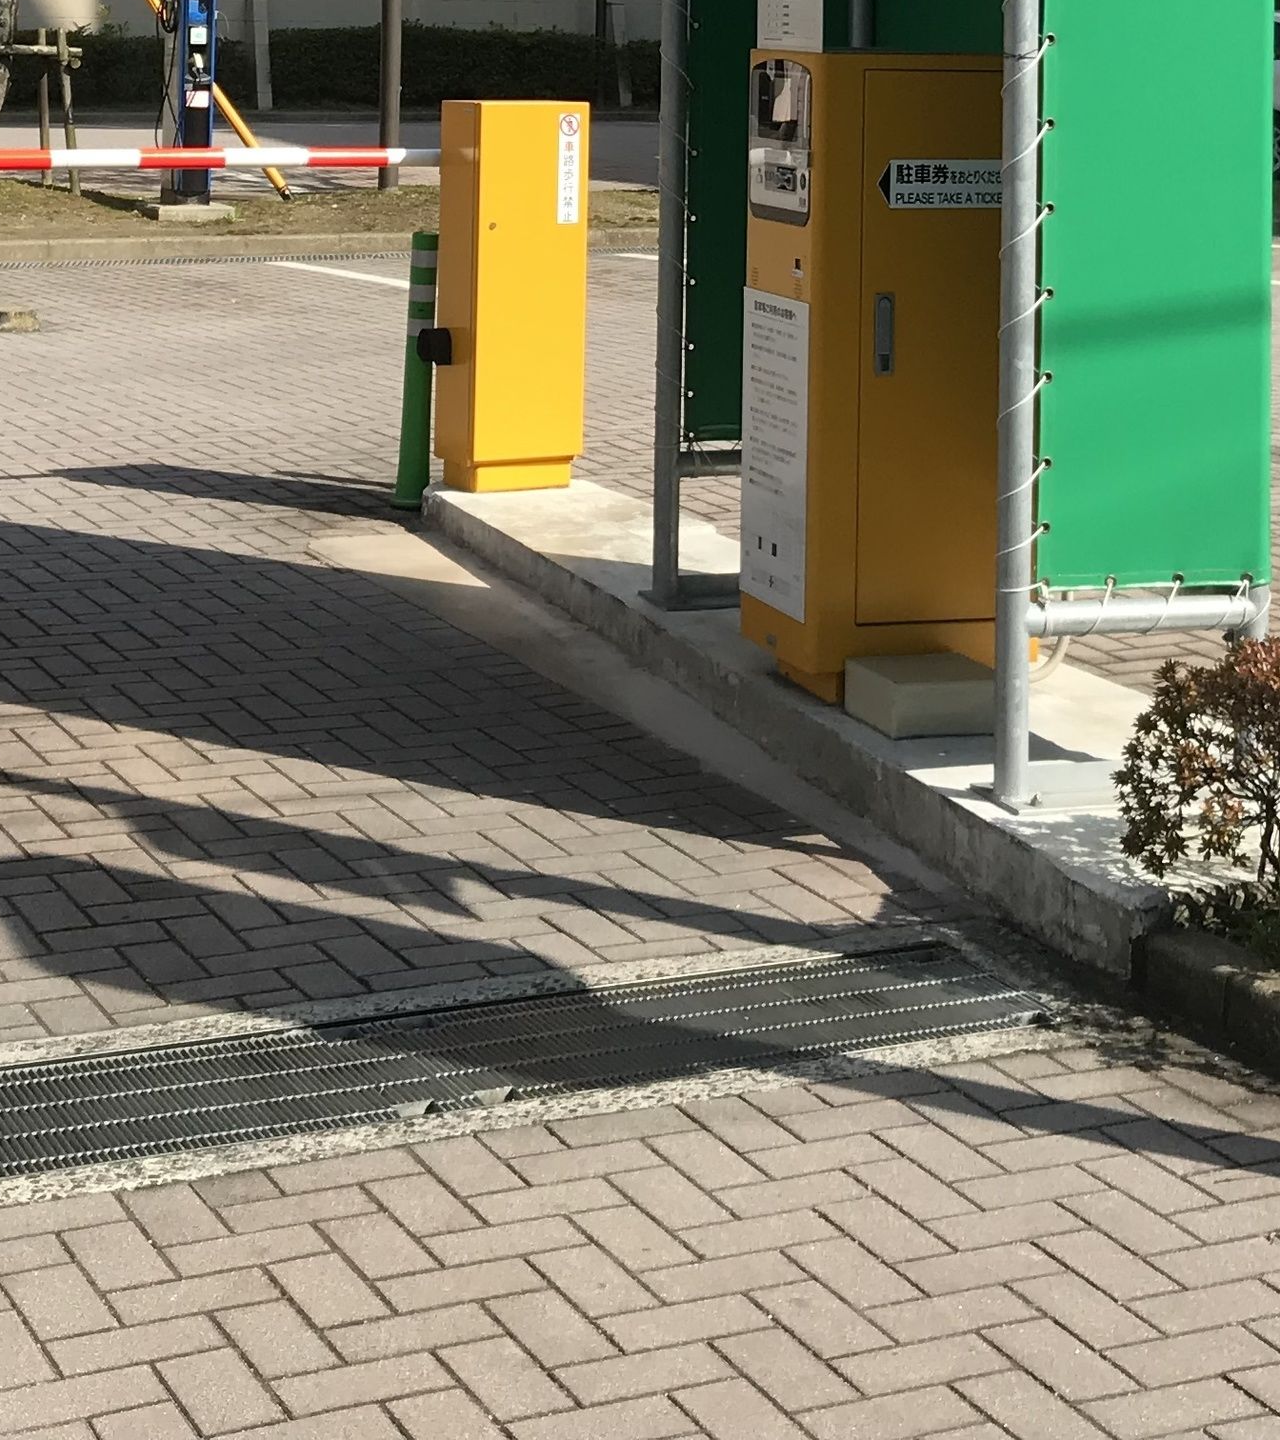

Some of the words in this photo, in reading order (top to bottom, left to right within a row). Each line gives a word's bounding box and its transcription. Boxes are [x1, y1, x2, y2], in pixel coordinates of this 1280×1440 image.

[895, 163, 1002, 185] 駐車券をおとりくださ
[895, 192, 934, 205] PLEASE
[937, 192, 963, 205] TAKE
[964, 192, 972, 205] A
[975, 192, 1002, 205] TICKE
